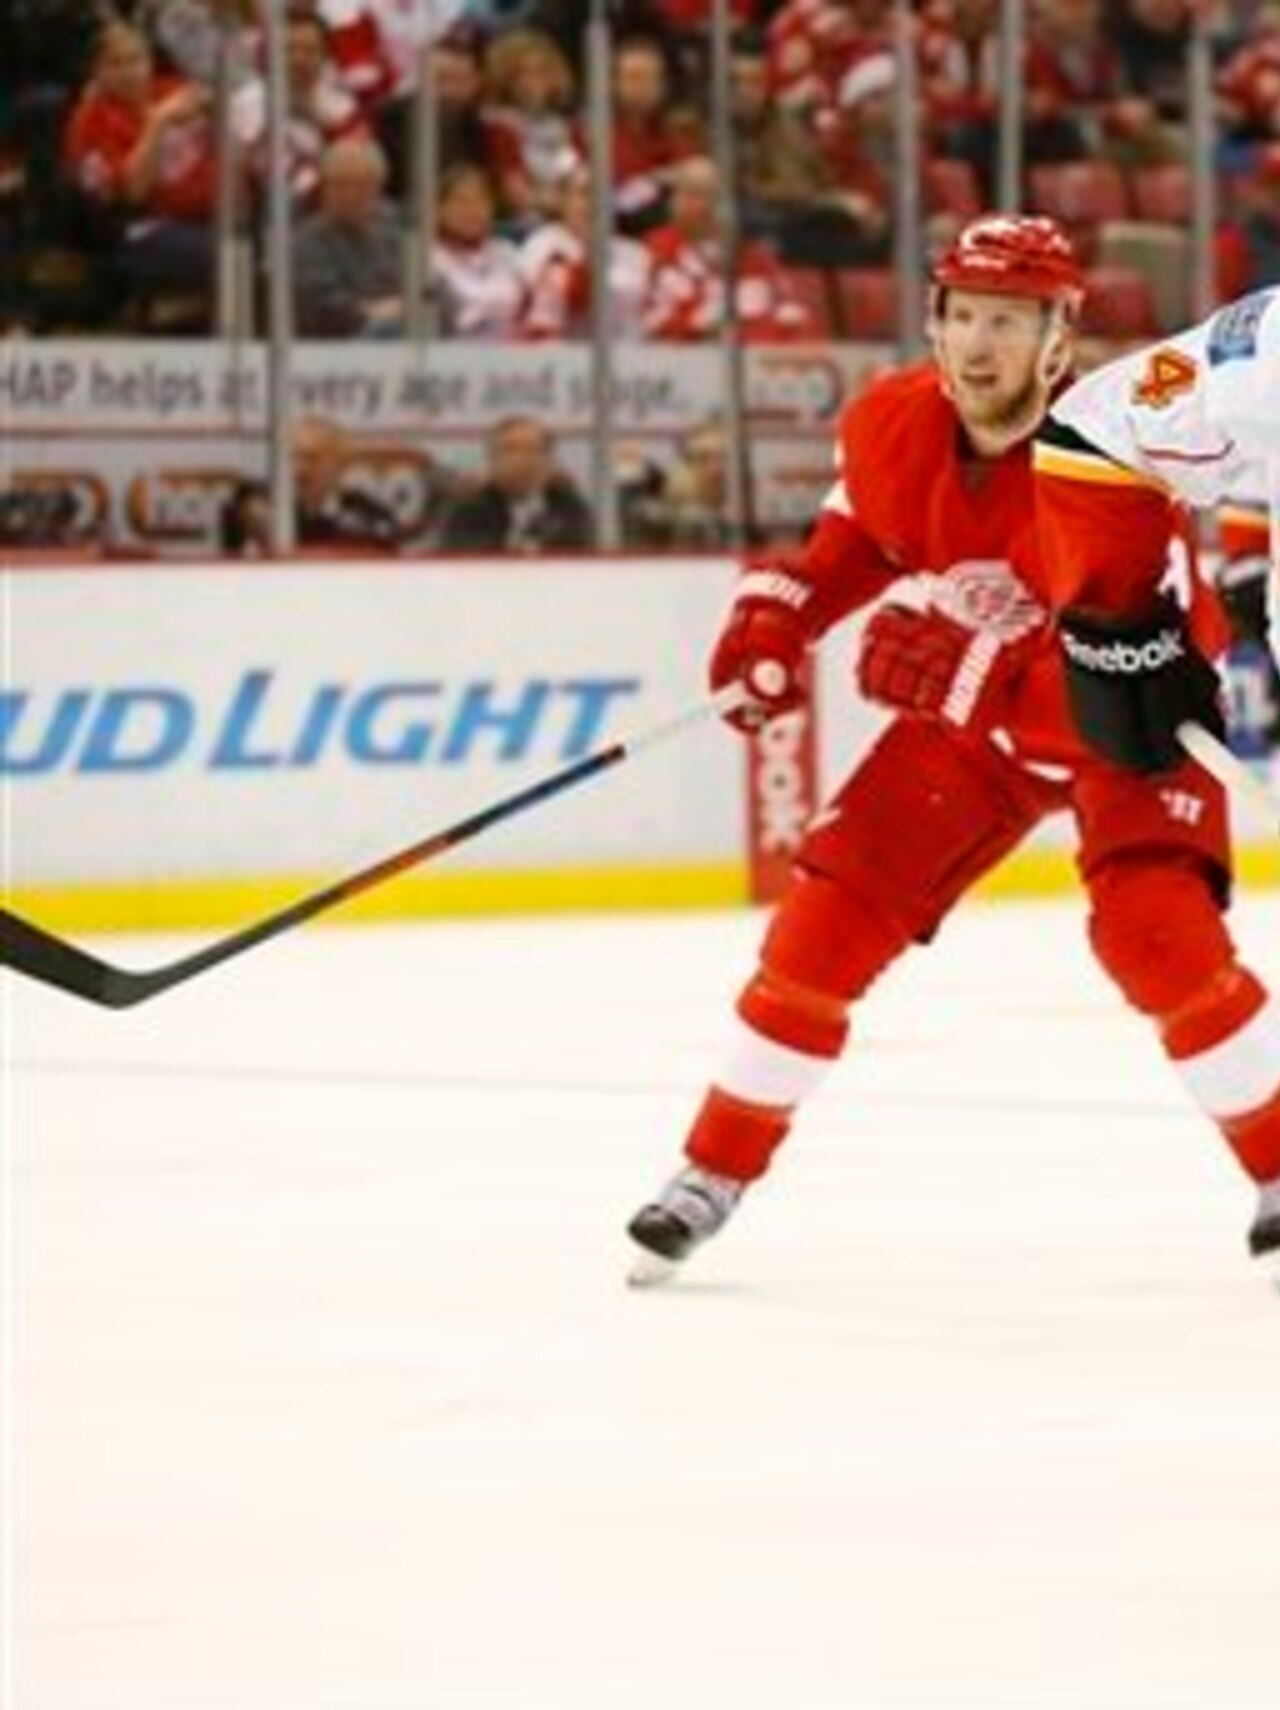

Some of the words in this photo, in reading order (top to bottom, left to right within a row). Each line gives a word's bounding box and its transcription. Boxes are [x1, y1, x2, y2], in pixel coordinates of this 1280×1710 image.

[88, 352, 204, 417] helps
[268, 370, 384, 420] very
[481, 361, 557, 408] and
[1132, 346, 1197, 408] 4
[205, 668, 640, 770] LIGHT
